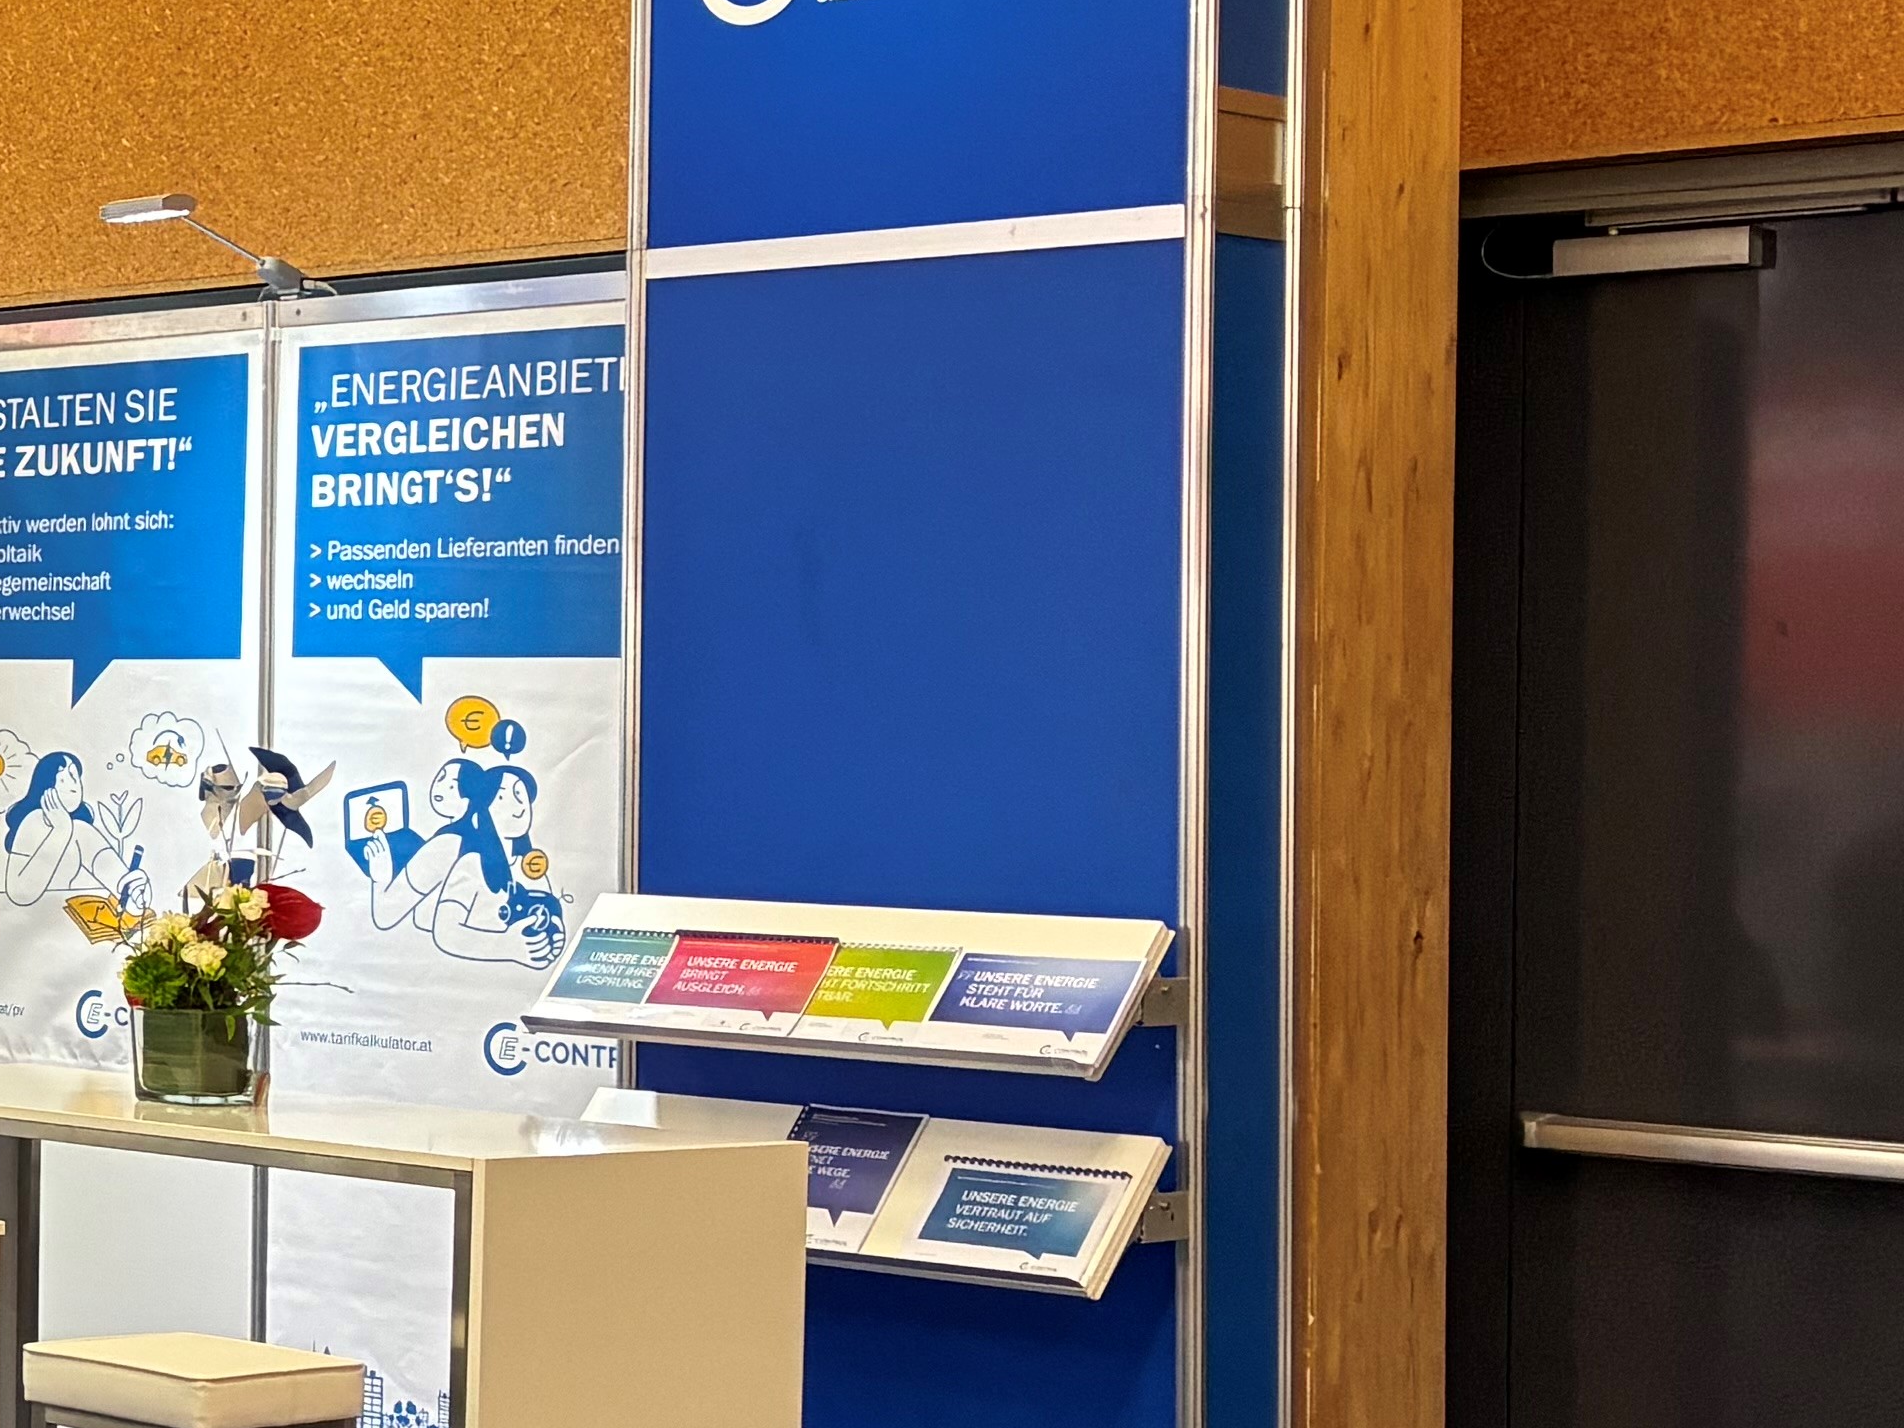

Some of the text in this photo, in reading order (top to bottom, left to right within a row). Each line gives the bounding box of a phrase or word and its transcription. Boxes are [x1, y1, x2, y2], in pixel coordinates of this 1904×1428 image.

[125, 388, 177, 423] SIE
[311, 412, 565, 458] VERGLEICHEN
[25, 514, 86, 533] werden
[92, 512, 131, 531] lohnt
[135, 510, 174, 530] sich:
[328, 534, 619, 561] Passenden Lieferanten finden
[326, 569, 413, 590] wechseln
[327, 598, 489, 623] und Geld sparen!
[687, 956, 798, 973] UNSERE ENERGIE
[974, 971, 1100, 989] UNSERE ENERGIE
[966, 984, 1044, 998] STEHT FÜR
[959, 996, 1063, 1013] KLARE WORTE.
[962, 1190, 1081, 1212] UNSERE ENERGIE
[956, 1204, 1052, 1223] VERTRAUT AUF
[947, 1217, 1028, 1236] SICHERHEIT.
